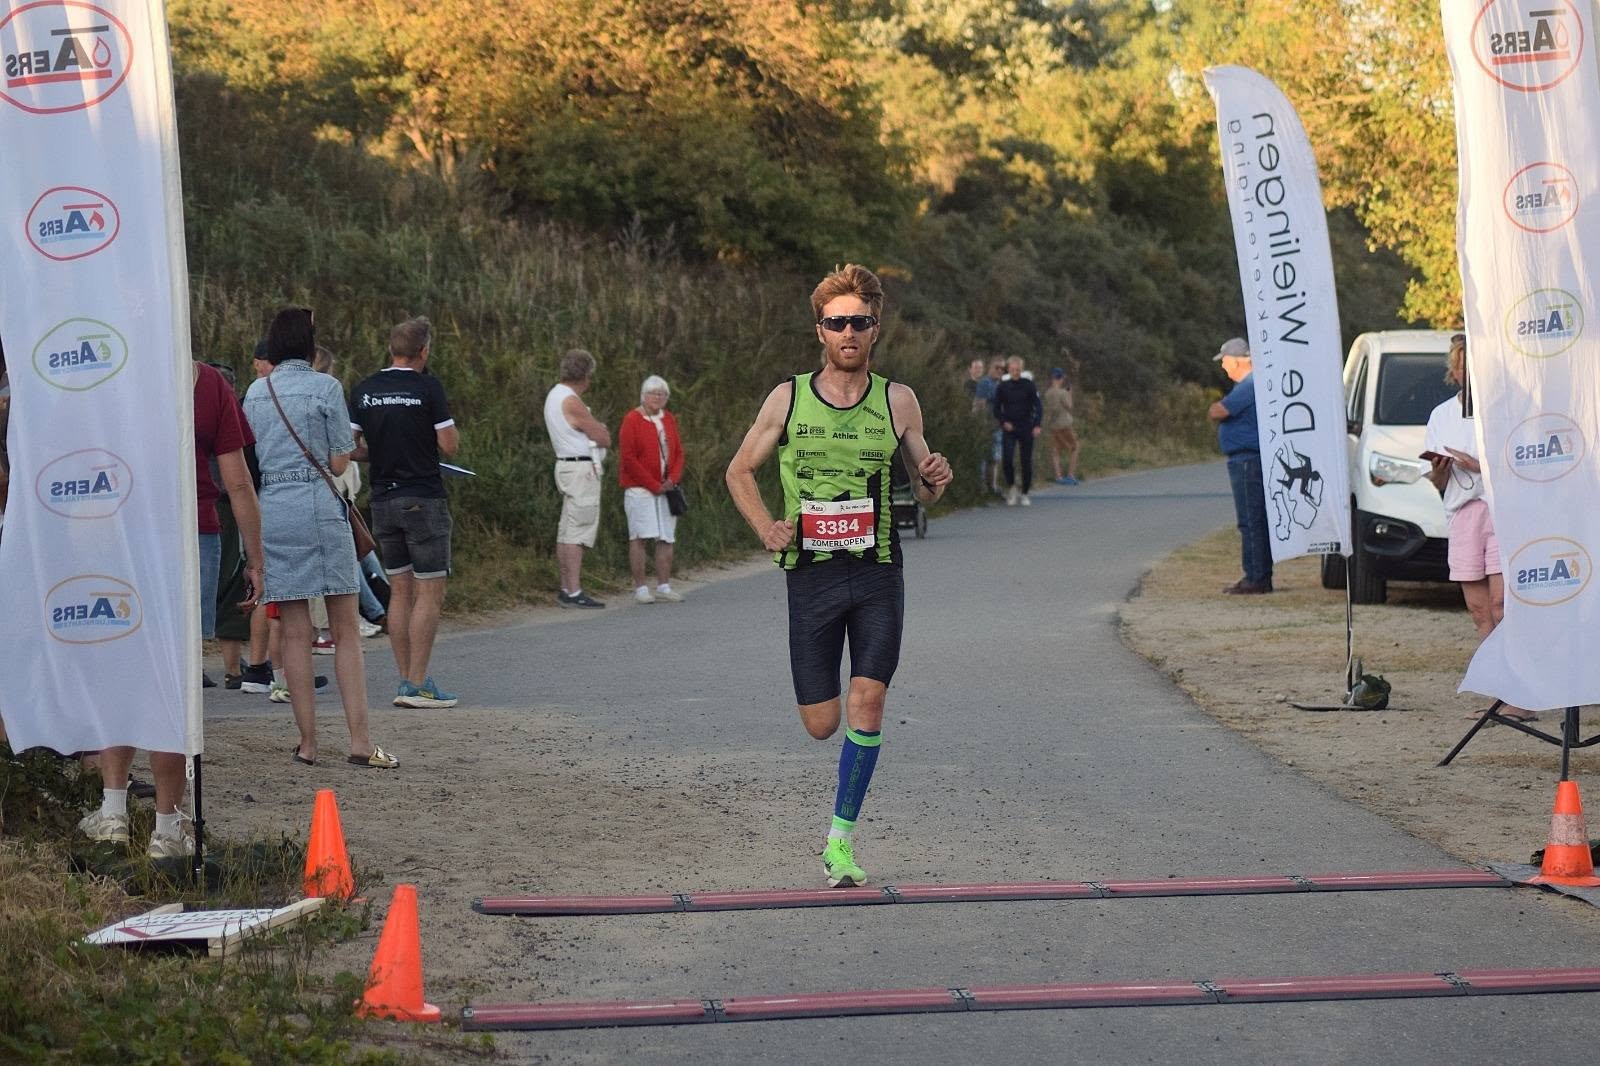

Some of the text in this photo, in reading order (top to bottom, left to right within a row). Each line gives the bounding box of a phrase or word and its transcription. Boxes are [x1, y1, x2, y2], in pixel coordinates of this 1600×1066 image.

[372, 396, 421, 407] De Wielingen
[816, 519, 860, 535] 3384
[812, 537, 865, 547] ZOMERLOPEN
